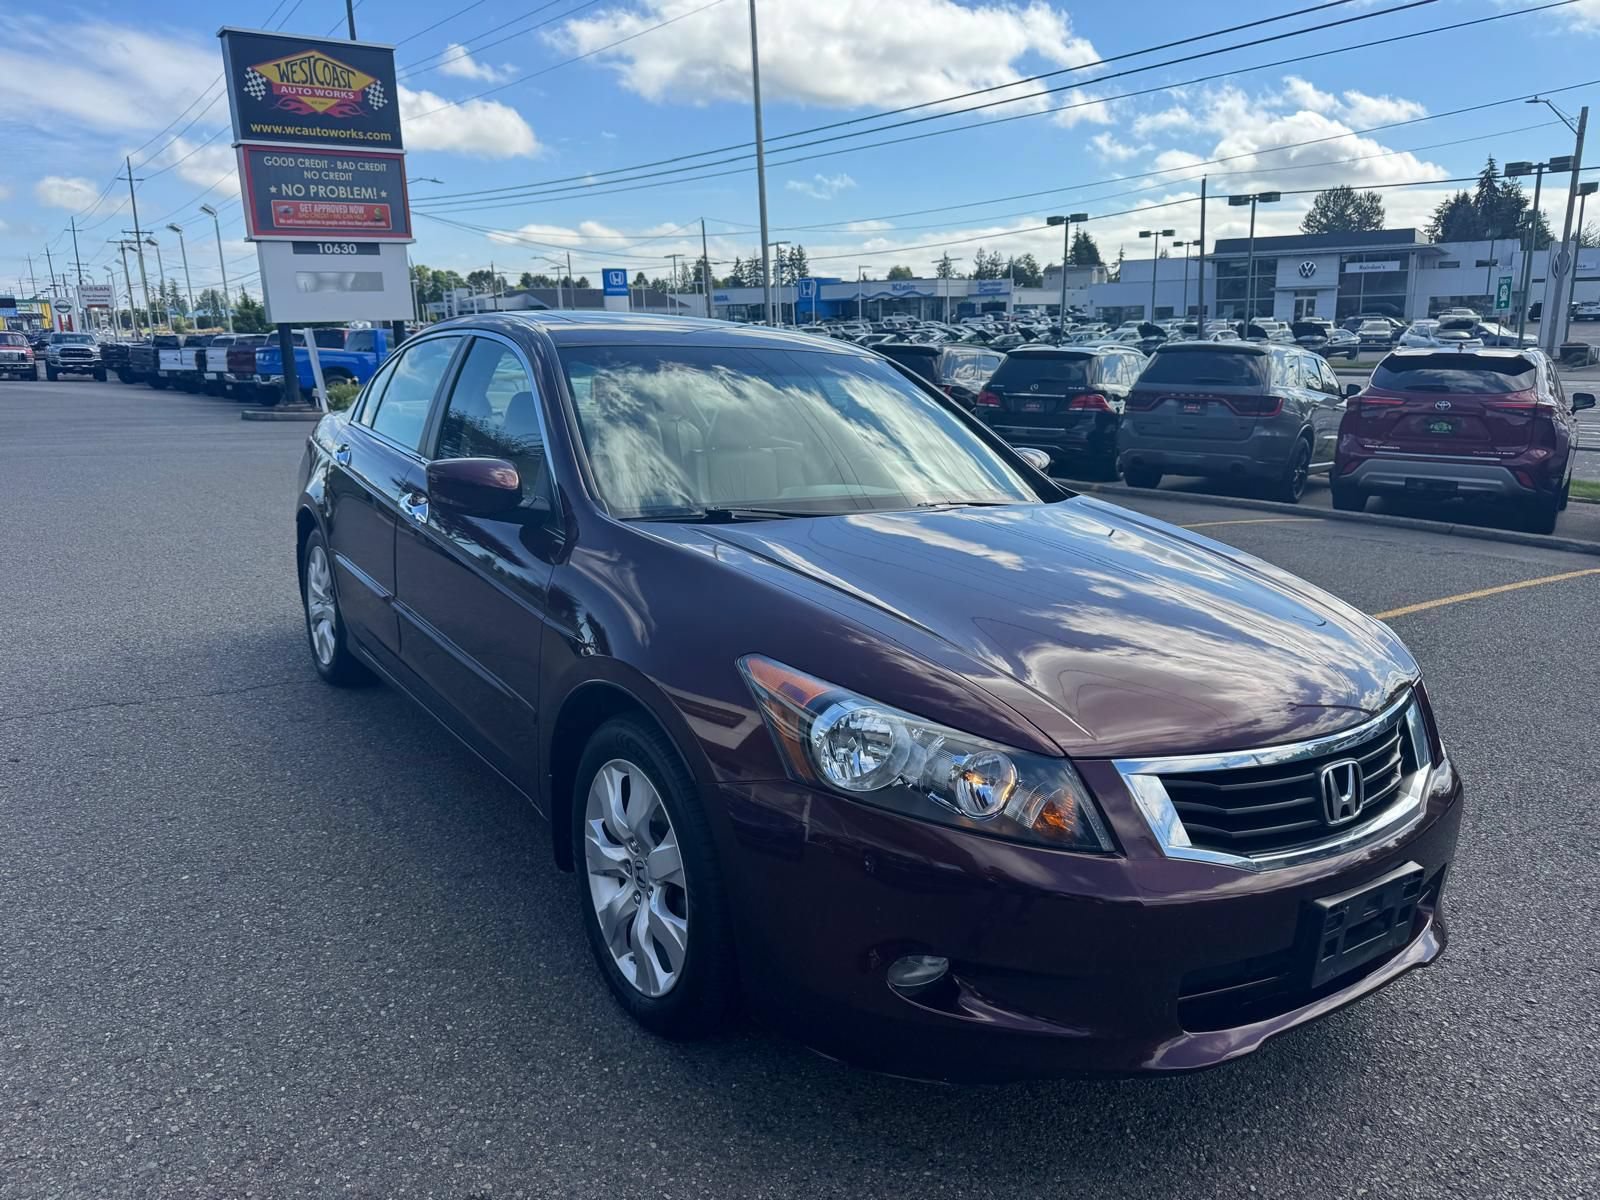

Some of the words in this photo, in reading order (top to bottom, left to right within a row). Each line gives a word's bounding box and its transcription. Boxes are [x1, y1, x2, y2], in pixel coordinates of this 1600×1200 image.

[280, 86, 312, 96] AUTO
[314, 89, 355, 99] WORKS
[250, 123, 392, 141] www.wcautoworks.com
[264, 156, 295, 167] GOOD
[297, 158, 328, 169] CREDIT
[336, 161, 355, 170] BAD
[357, 162, 387, 172] CREDIT
[303, 170, 320, 179] NO
[321, 171, 352, 181] CREDIT
[281, 183, 305, 197] NO
[309, 184, 378, 200] PROBLEM!
[300, 203, 312, 212] GET
[313, 203, 348, 214] APPROVED
[349, 205, 364, 214] NOW
[317, 243, 357, 254] 10630
